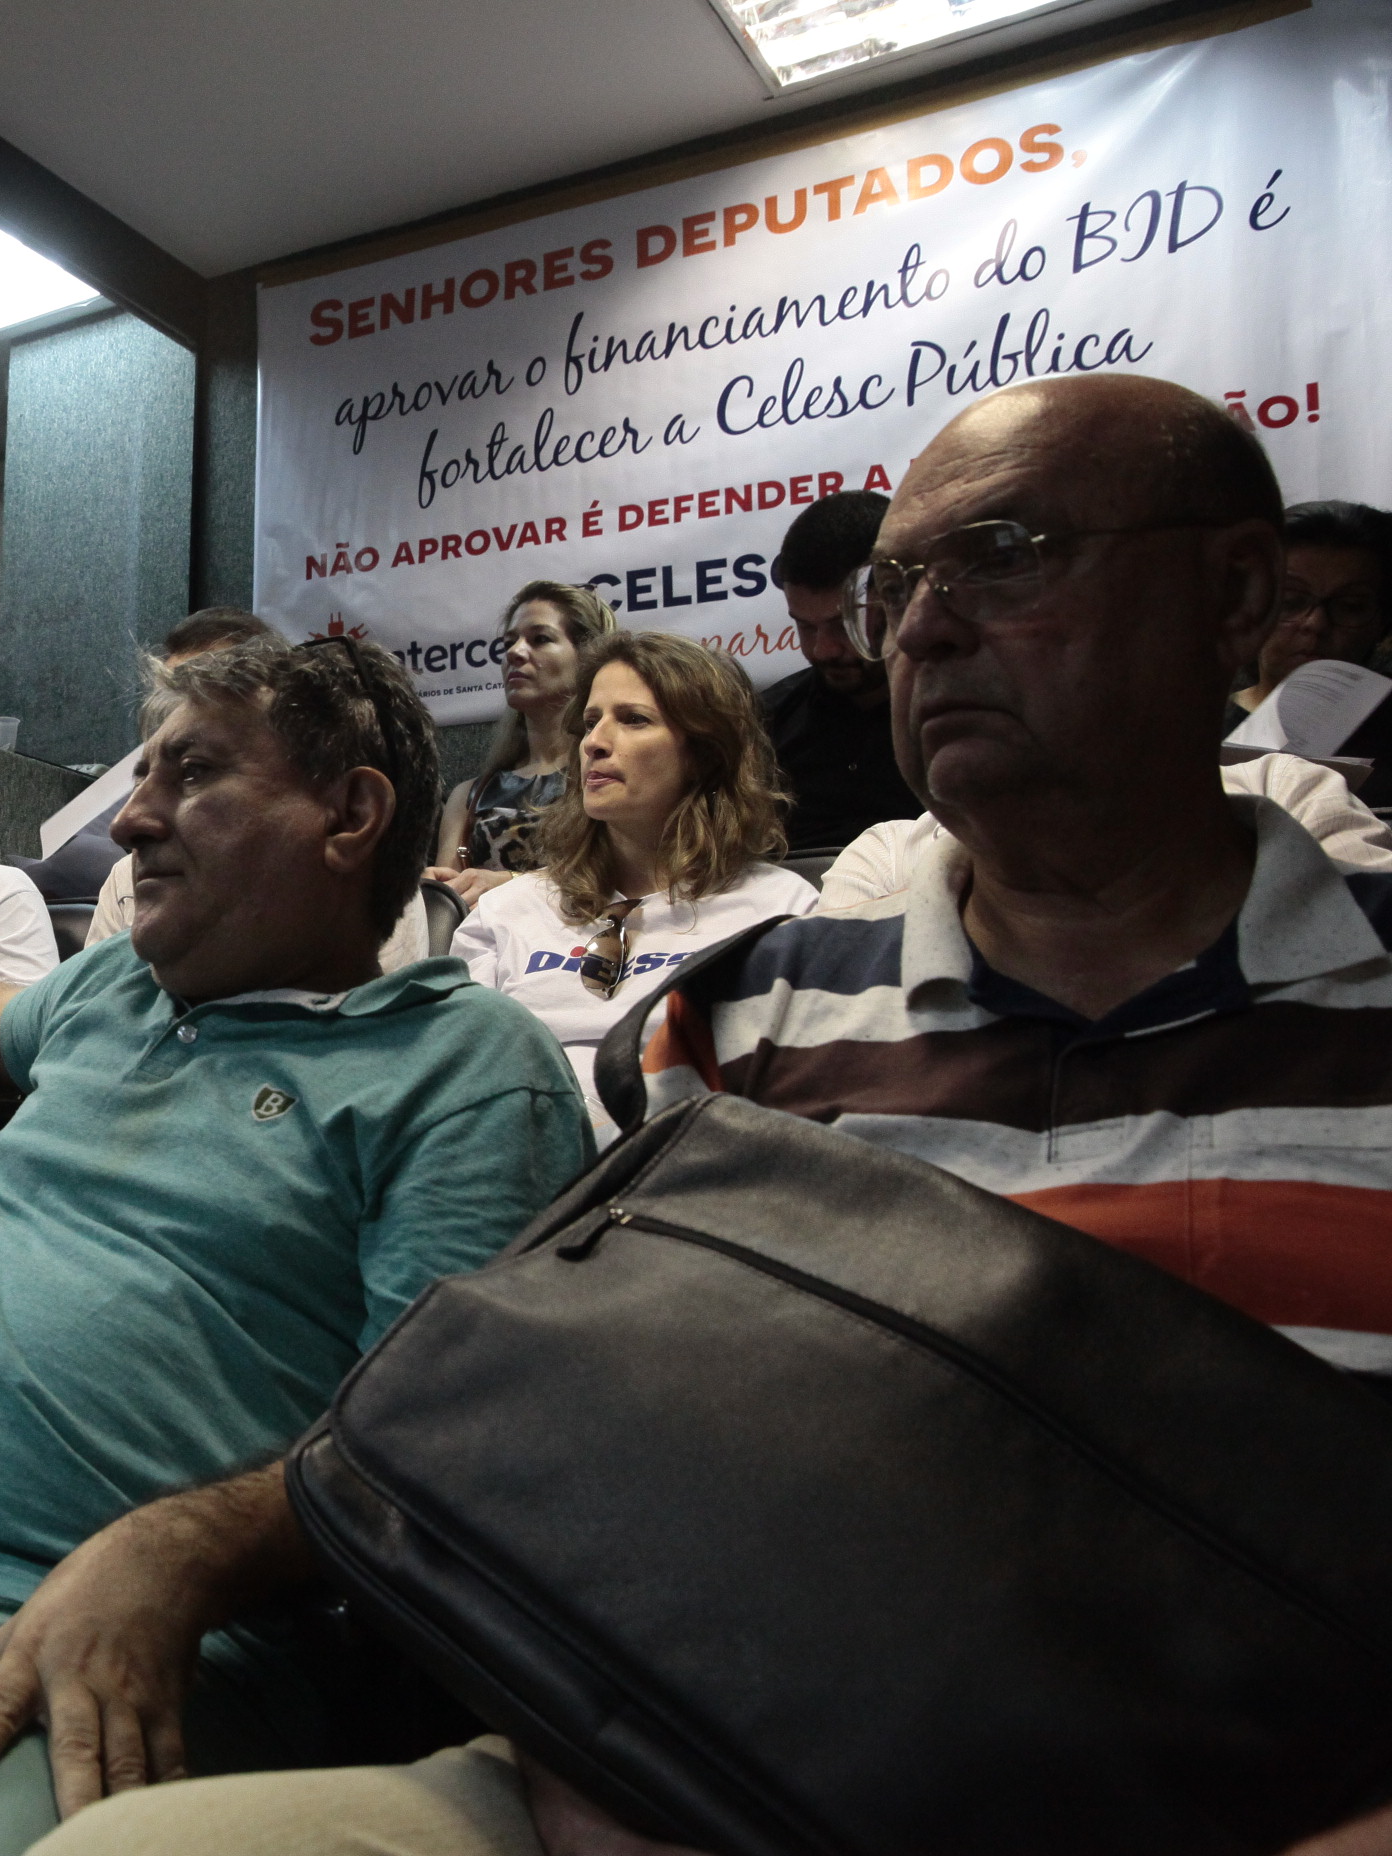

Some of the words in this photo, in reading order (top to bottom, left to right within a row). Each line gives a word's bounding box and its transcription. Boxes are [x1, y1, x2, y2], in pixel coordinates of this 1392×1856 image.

[309, 238, 614, 347] SENHORES
[636, 122, 1089, 269] DEPUTADOS,
[335, 356, 515, 455] aprovar
[525, 355, 547, 387] o
[564, 242, 950, 396] financiamento
[973, 218, 1046, 289] do
[1248, 168, 1291, 231] é
[418, 407, 651, 509] fortalecer
[663, 411, 701, 446] a
[716, 357, 896, 437] Celesc
[907, 307, 1154, 407] Pública
[305, 541, 380, 580] NÃO
[391, 516, 567, 568] APROVAR
[582, 500, 604, 538] É
[617, 470, 845, 533] DEFENDER
[862, 463, 893, 492] A
